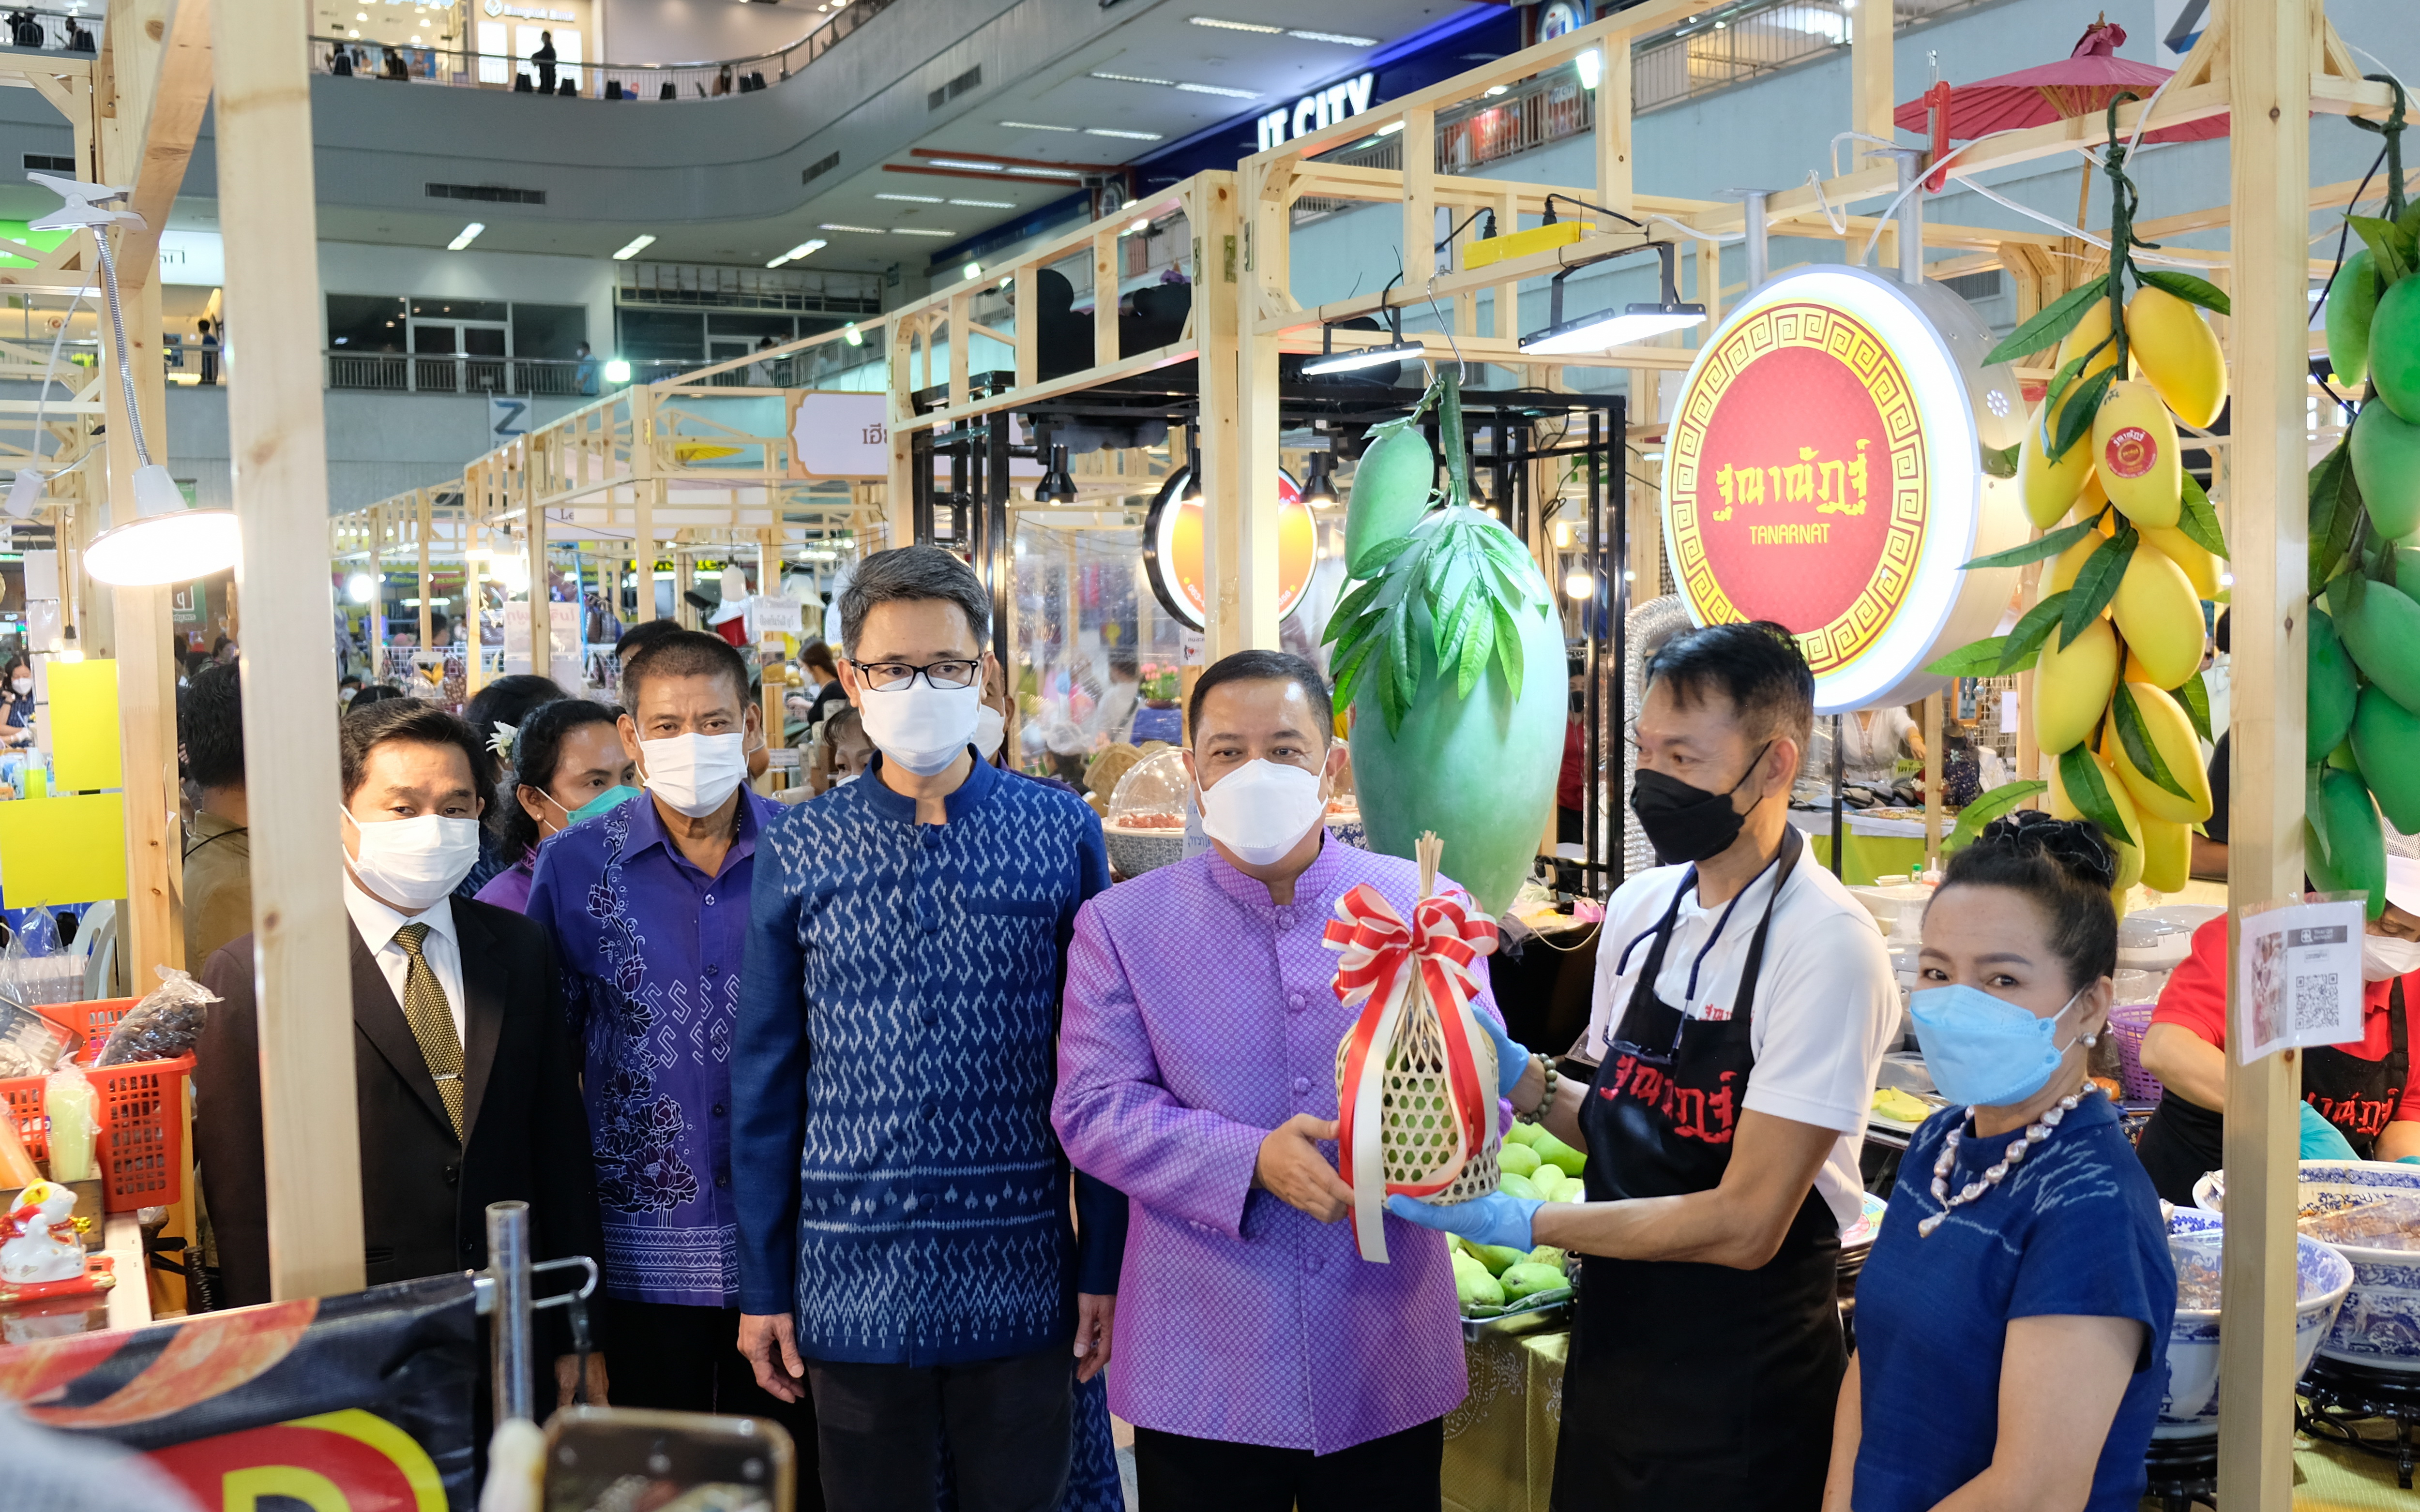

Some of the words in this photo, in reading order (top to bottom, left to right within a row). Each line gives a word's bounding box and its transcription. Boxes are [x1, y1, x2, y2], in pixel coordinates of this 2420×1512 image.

[504, 4, 547, 19] Bangkok
[548, 9, 575, 22] Bank
[1257, 107, 1289, 153] IT
[1292, 72, 1375, 139] CITY
[1749, 523, 1831, 545] TANARNAT
